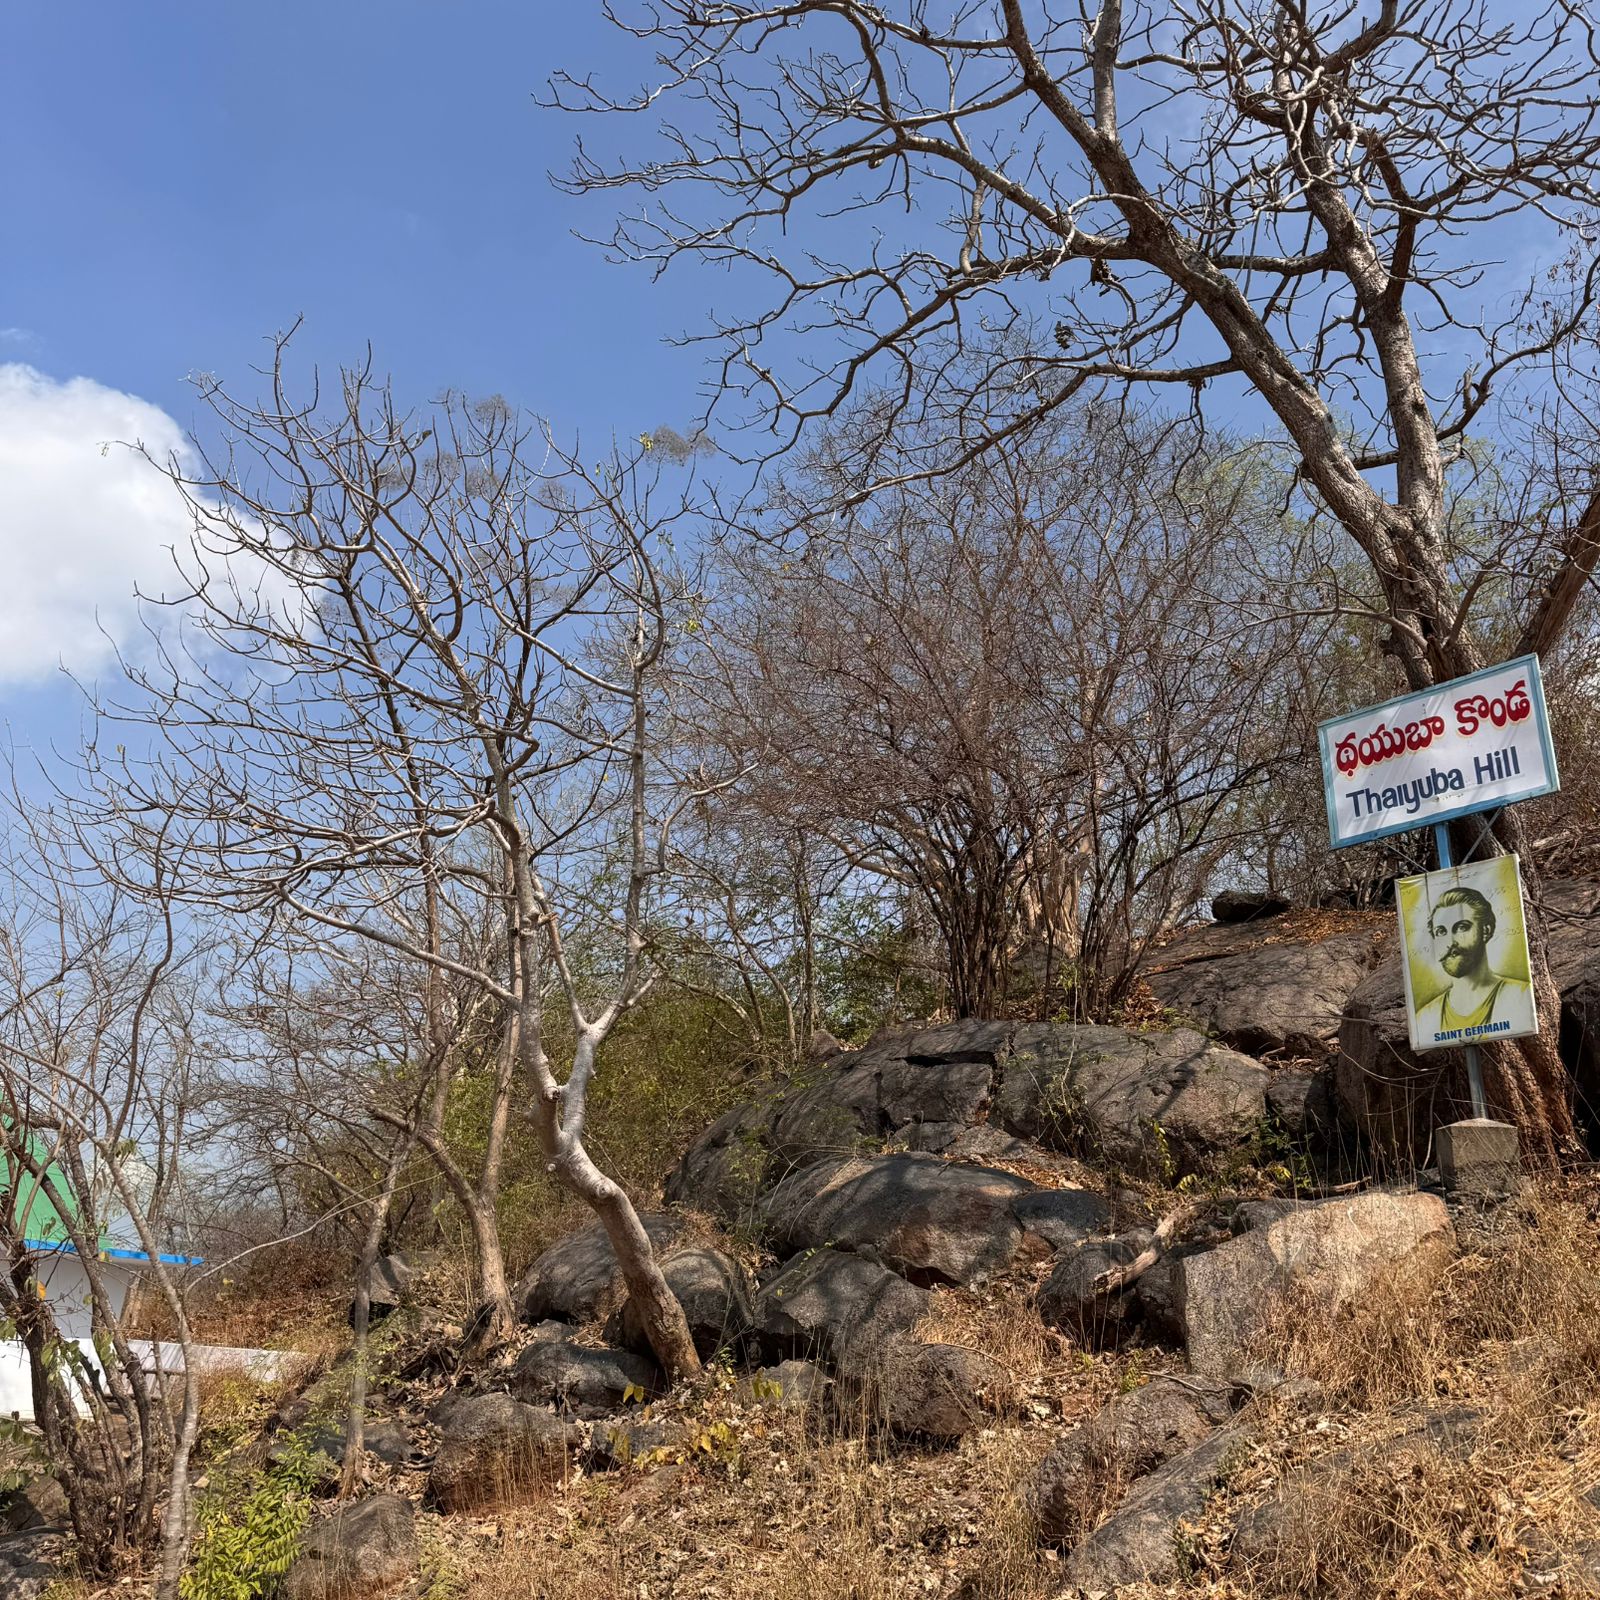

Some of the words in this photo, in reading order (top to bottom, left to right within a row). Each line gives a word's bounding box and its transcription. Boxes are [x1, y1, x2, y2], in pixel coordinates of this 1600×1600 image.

[1454, 680, 1530, 735] కొండ
[1473, 746, 1520, 785] Hill
[1434, 1029, 1463, 1042] SAINT
[1465, 1020, 1510, 1037] GERMAIN
